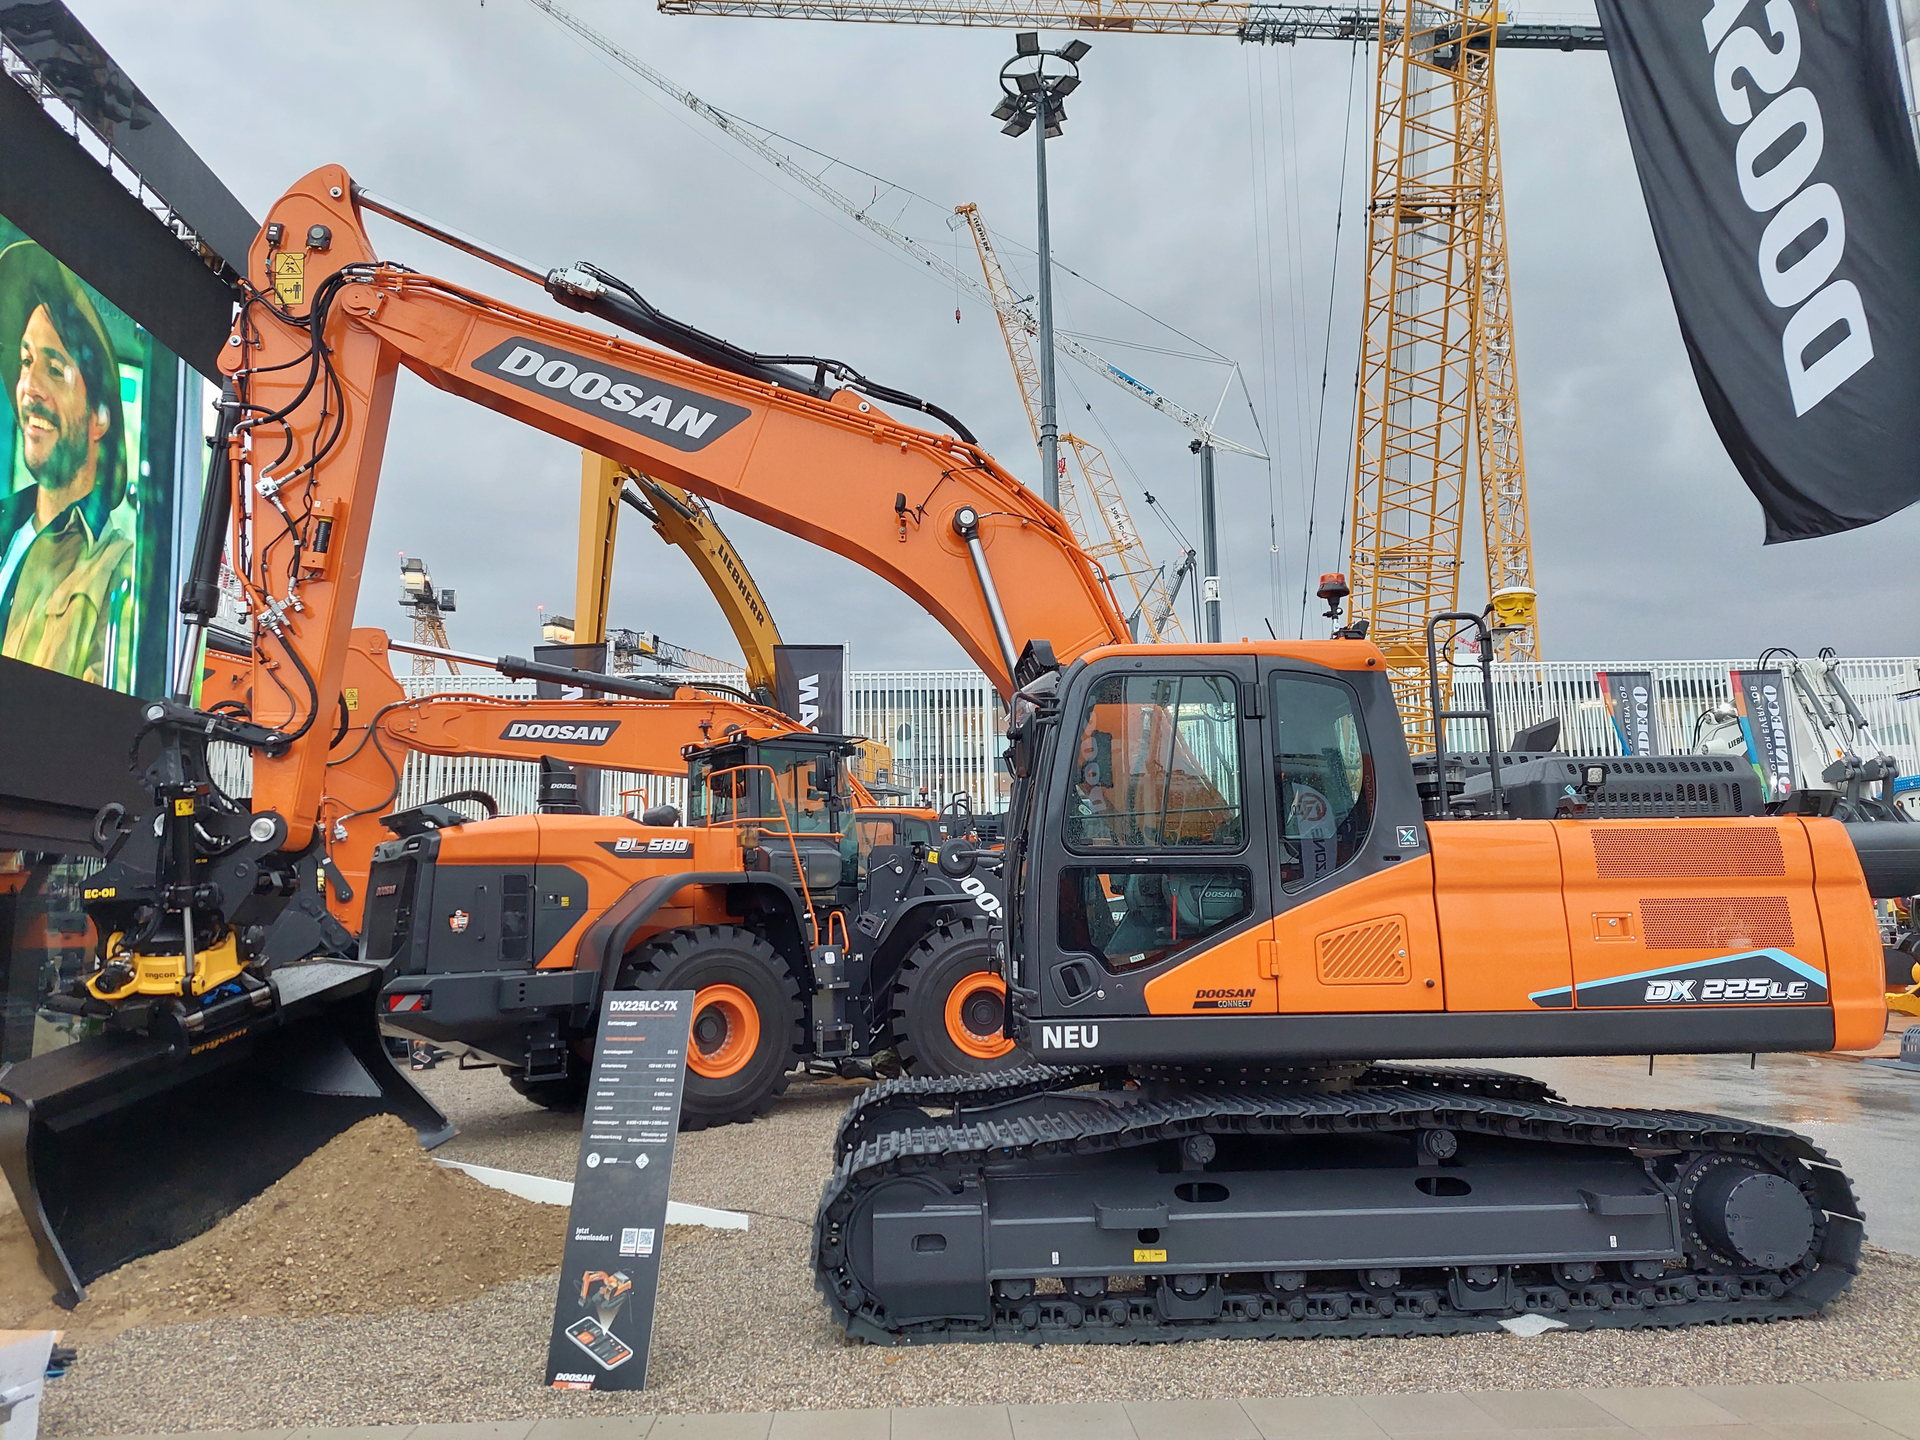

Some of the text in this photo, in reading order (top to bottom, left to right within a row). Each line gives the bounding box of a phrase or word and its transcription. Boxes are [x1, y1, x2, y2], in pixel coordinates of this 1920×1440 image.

[498, 346, 718, 439] DOOSAN
[717, 543, 764, 627] LIEBHERR
[799, 673, 819, 734] WA
[508, 724, 610, 741] DOOSAN
[1728, 736, 1745, 749] LIEBH
[615, 837, 689, 853] DL 580
[145, 971, 176, 980] engcon
[1196, 988, 1256, 998] DOOSAN
[1645, 980, 1697, 1002] DX
[610, 1000, 678, 1011] DX225LC-7X
[1218, 1000, 1251, 1008] CONNECT
[1042, 1025, 1099, 1049] NEU
[555, 1372, 596, 1382] DOOSAN
